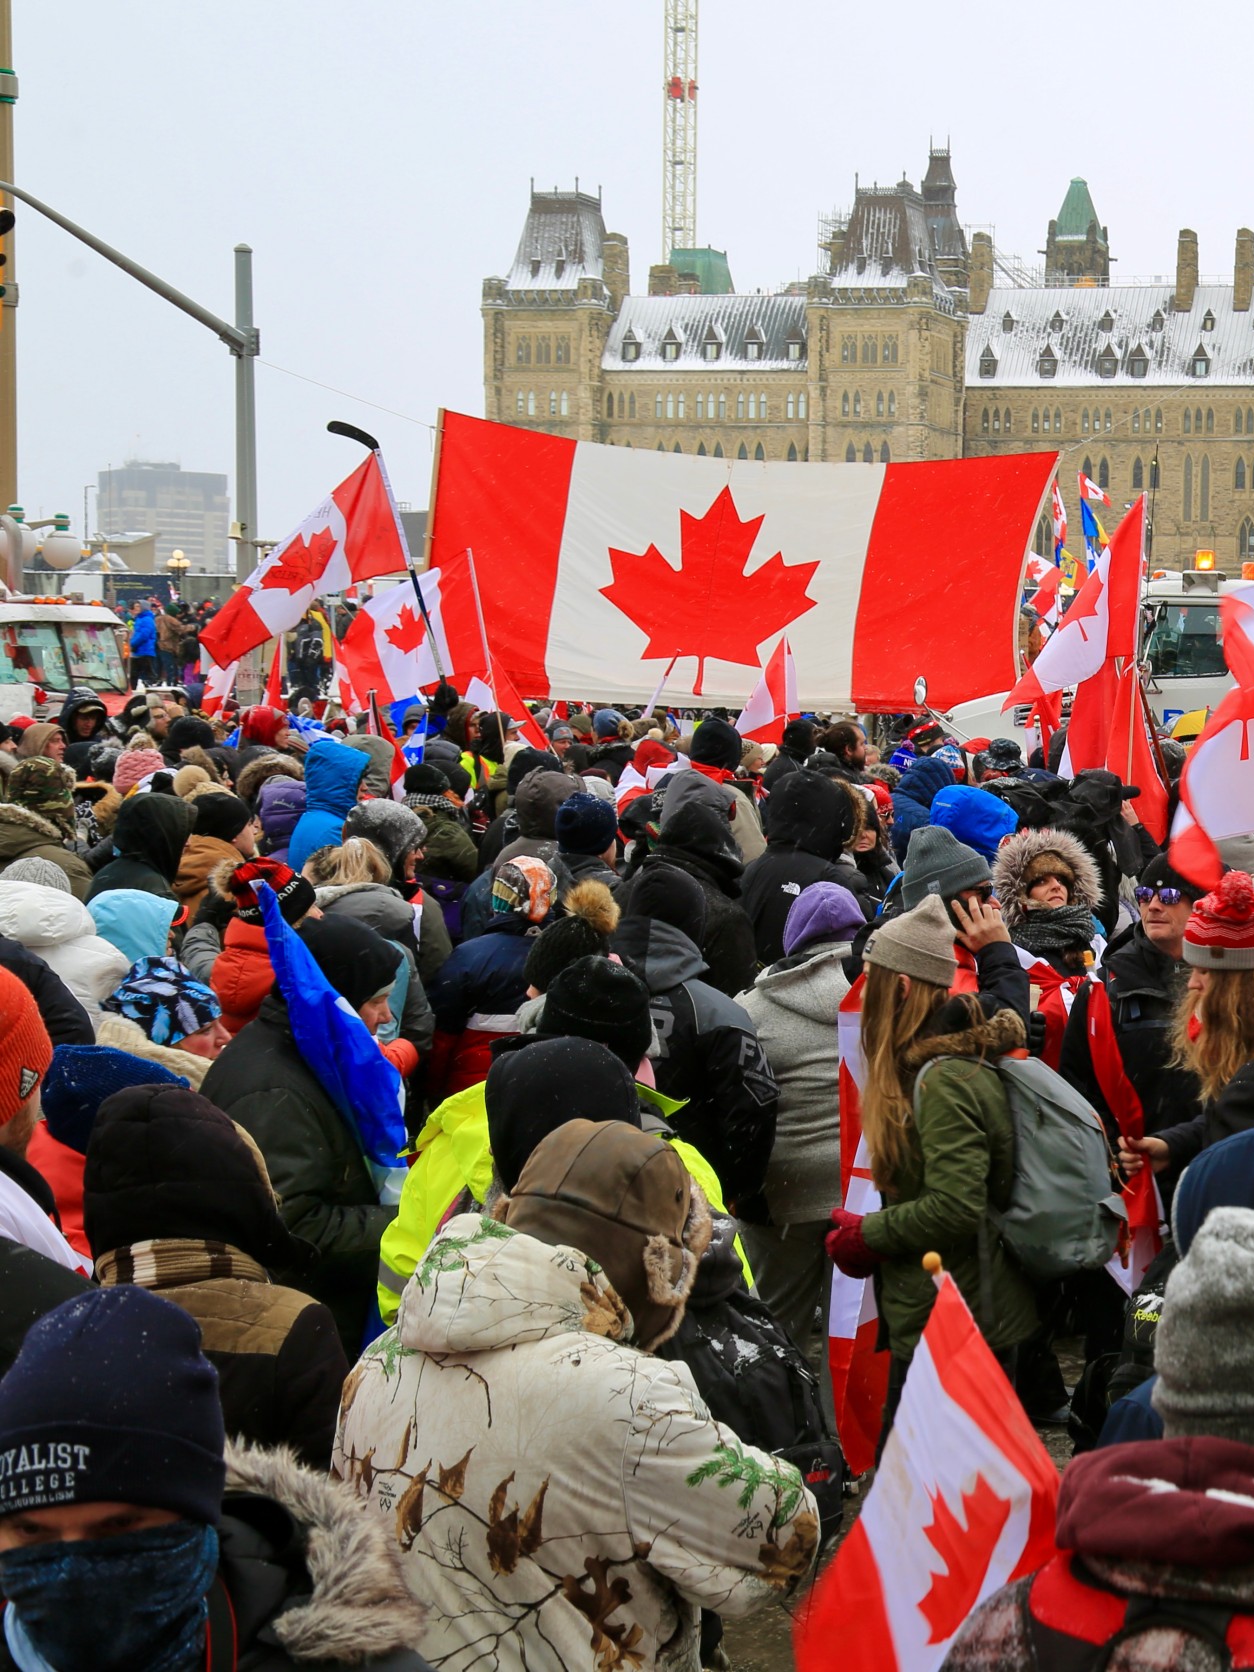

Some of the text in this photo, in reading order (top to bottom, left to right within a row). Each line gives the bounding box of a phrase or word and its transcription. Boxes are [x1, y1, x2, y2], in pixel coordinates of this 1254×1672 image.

[738, 1035, 775, 1081] FX
[1134, 1308, 1162, 1323] Reeb
[0, 1443, 91, 1480] OYALIST
[0, 1471, 75, 1499] OLLEGE
